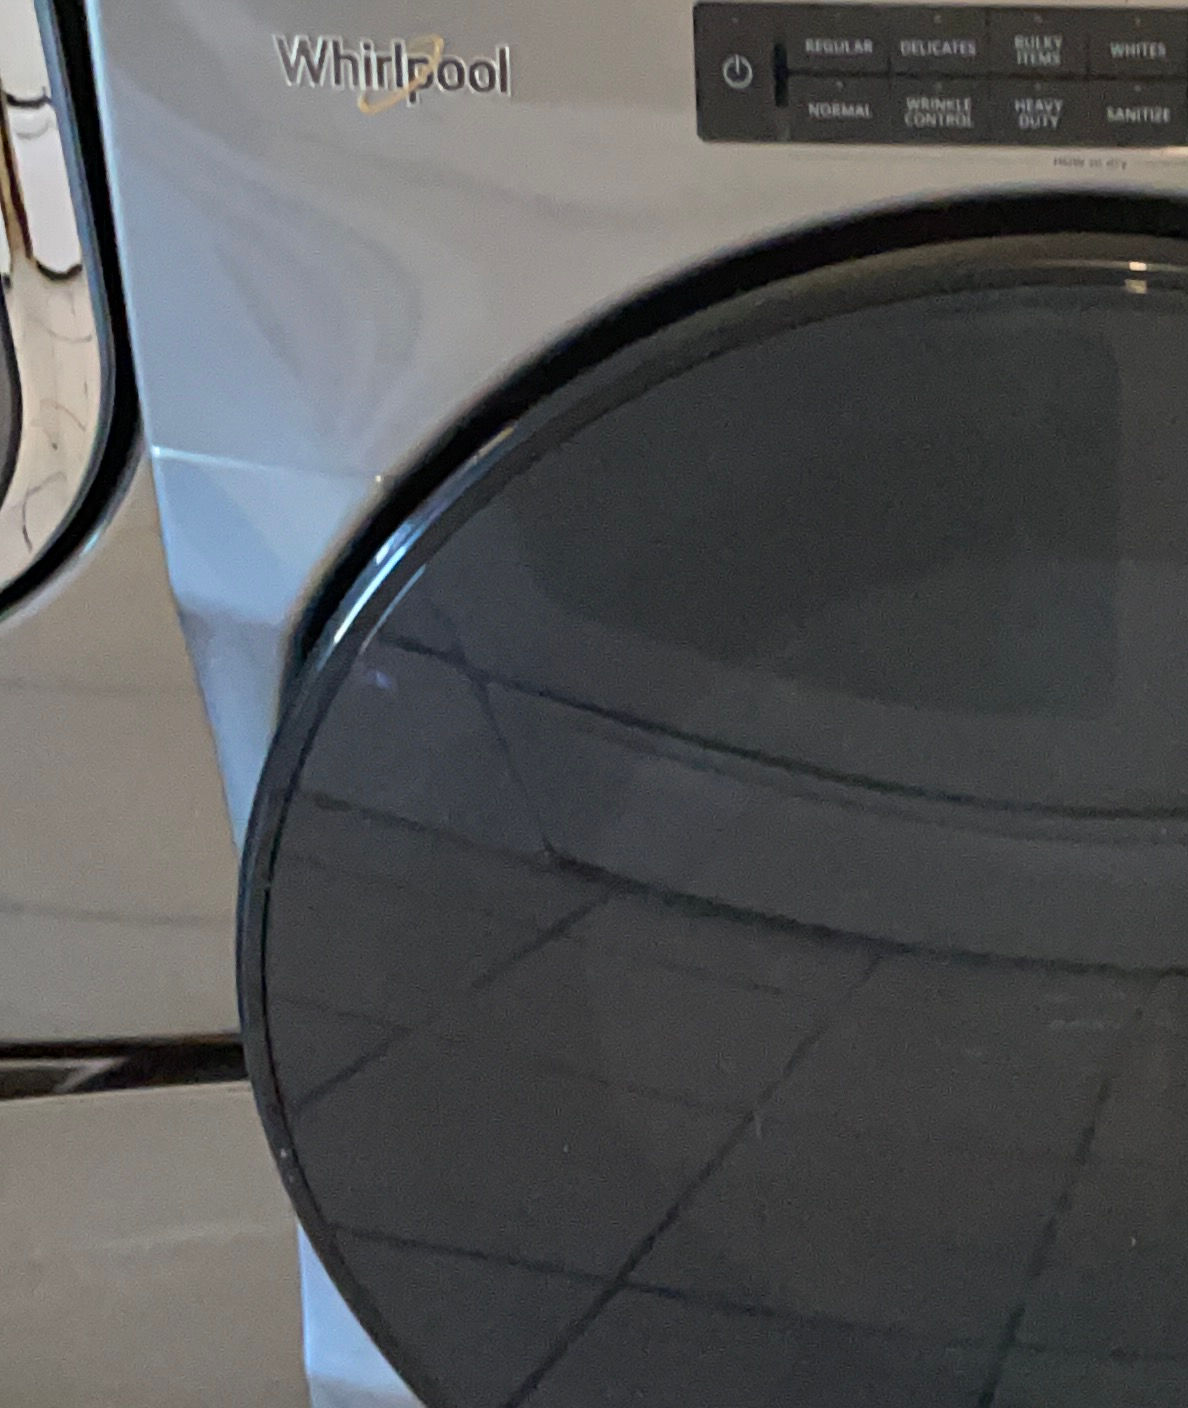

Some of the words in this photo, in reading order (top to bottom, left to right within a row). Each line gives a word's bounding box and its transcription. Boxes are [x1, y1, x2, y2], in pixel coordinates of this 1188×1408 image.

[805, 38, 873, 54] REGULAR
[900, 41, 976, 57] DELICATES
[1014, 34, 1063, 49] BULKY
[1016, 50, 1061, 66] ITEMS
[1110, 42, 1166, 59] WHITES
[272, 34, 511, 107] Whirlpool
[808, 103, 872, 119] NORMAL
[905, 96, 972, 112] WRINKLE
[1014, 98, 1063, 113] HEAVY
[904, 112, 974, 129] CONTROL
[1018, 113, 1060, 130] DUTY
[1106, 106, 1171, 124] SANITIZE
